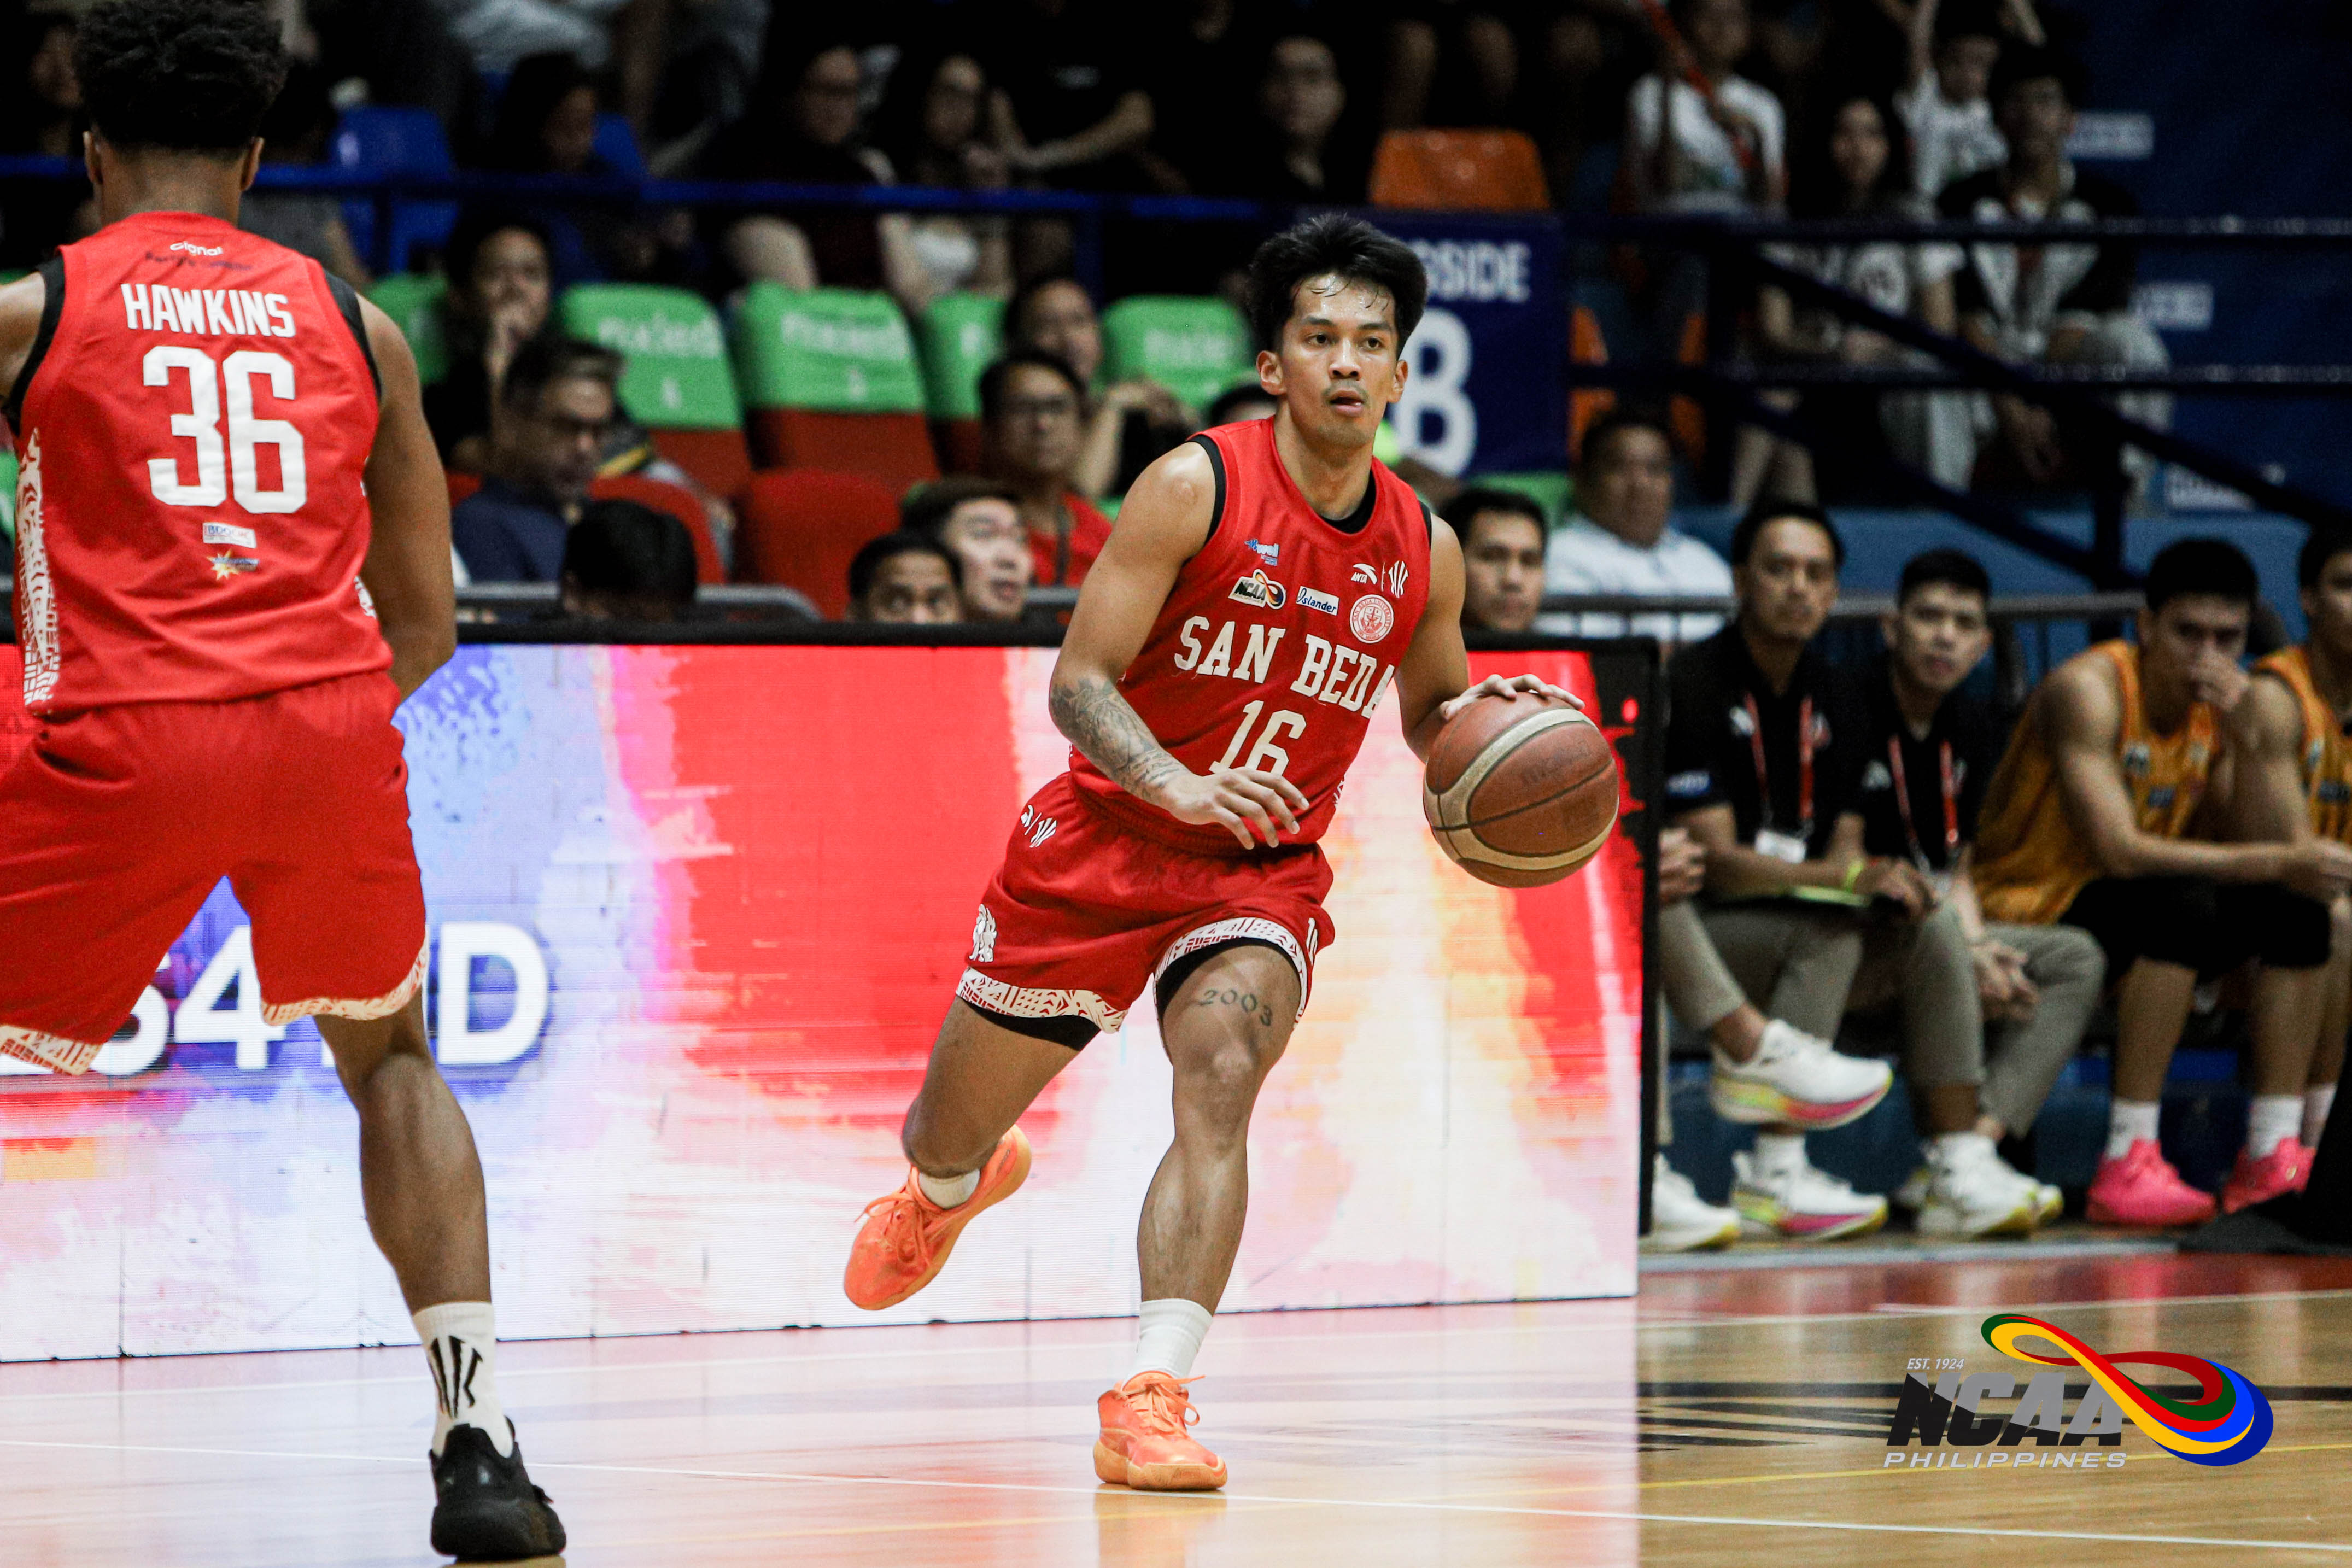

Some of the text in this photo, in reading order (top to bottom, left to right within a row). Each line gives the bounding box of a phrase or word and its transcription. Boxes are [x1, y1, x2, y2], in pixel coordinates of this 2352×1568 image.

[120, 283, 296, 338] HAWKINS
[143, 345, 308, 514] 36
[1234, 581, 1267, 601] NCAA
[1296, 588, 1337, 613] Islander
[1350, 572, 1368, 584] ANTA
[1174, 616, 1286, 684] SAN
[1209, 700, 1307, 777] 16
[1198, 990, 1273, 1027] 2003
